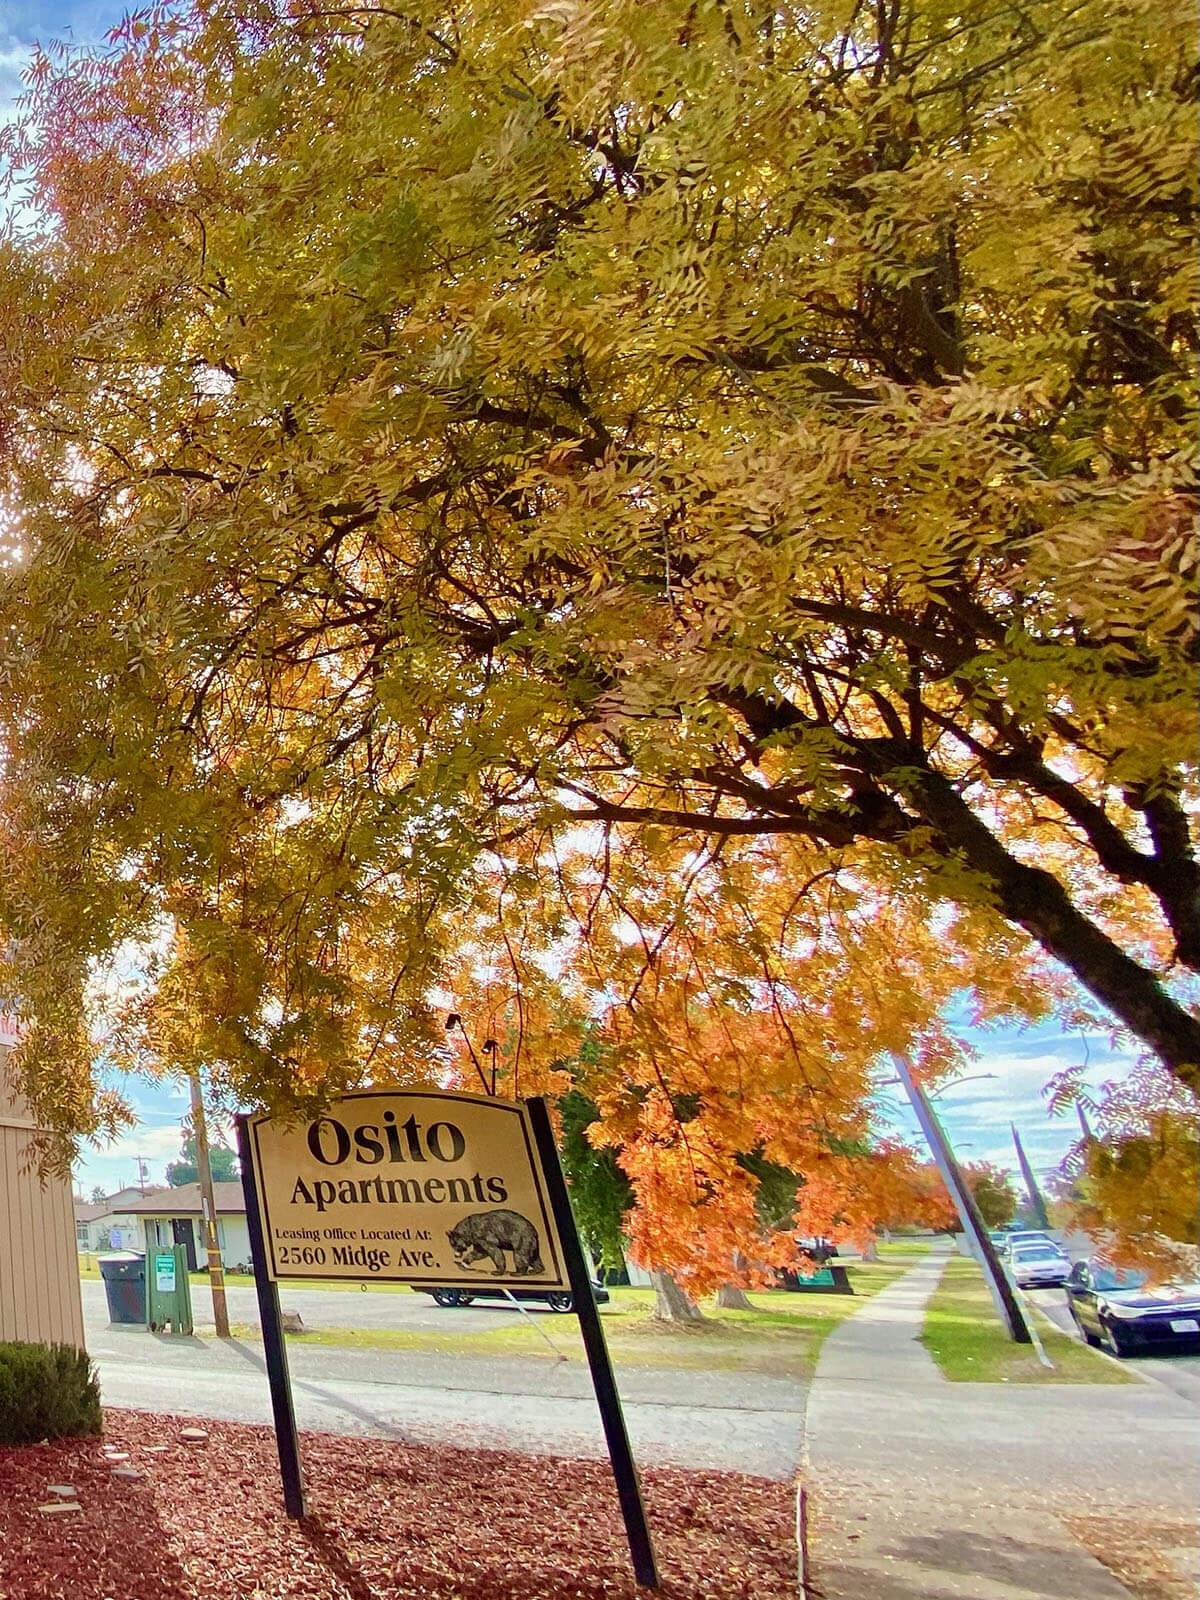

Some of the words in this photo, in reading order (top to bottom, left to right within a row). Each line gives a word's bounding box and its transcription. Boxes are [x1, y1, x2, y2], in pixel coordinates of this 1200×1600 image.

[307, 1110, 466, 1166] Osito
[290, 1172, 508, 1212] Apartments
[275, 1227, 321, 1242] Leasing
[323, 1227, 357, 1240] Office
[361, 1228, 411, 1241] Located
[415, 1229, 433, 1241] At:
[278, 1246, 327, 1265] 2560
[331, 1245, 391, 1272] Midge
[398, 1247, 441, 1268] Ave.
